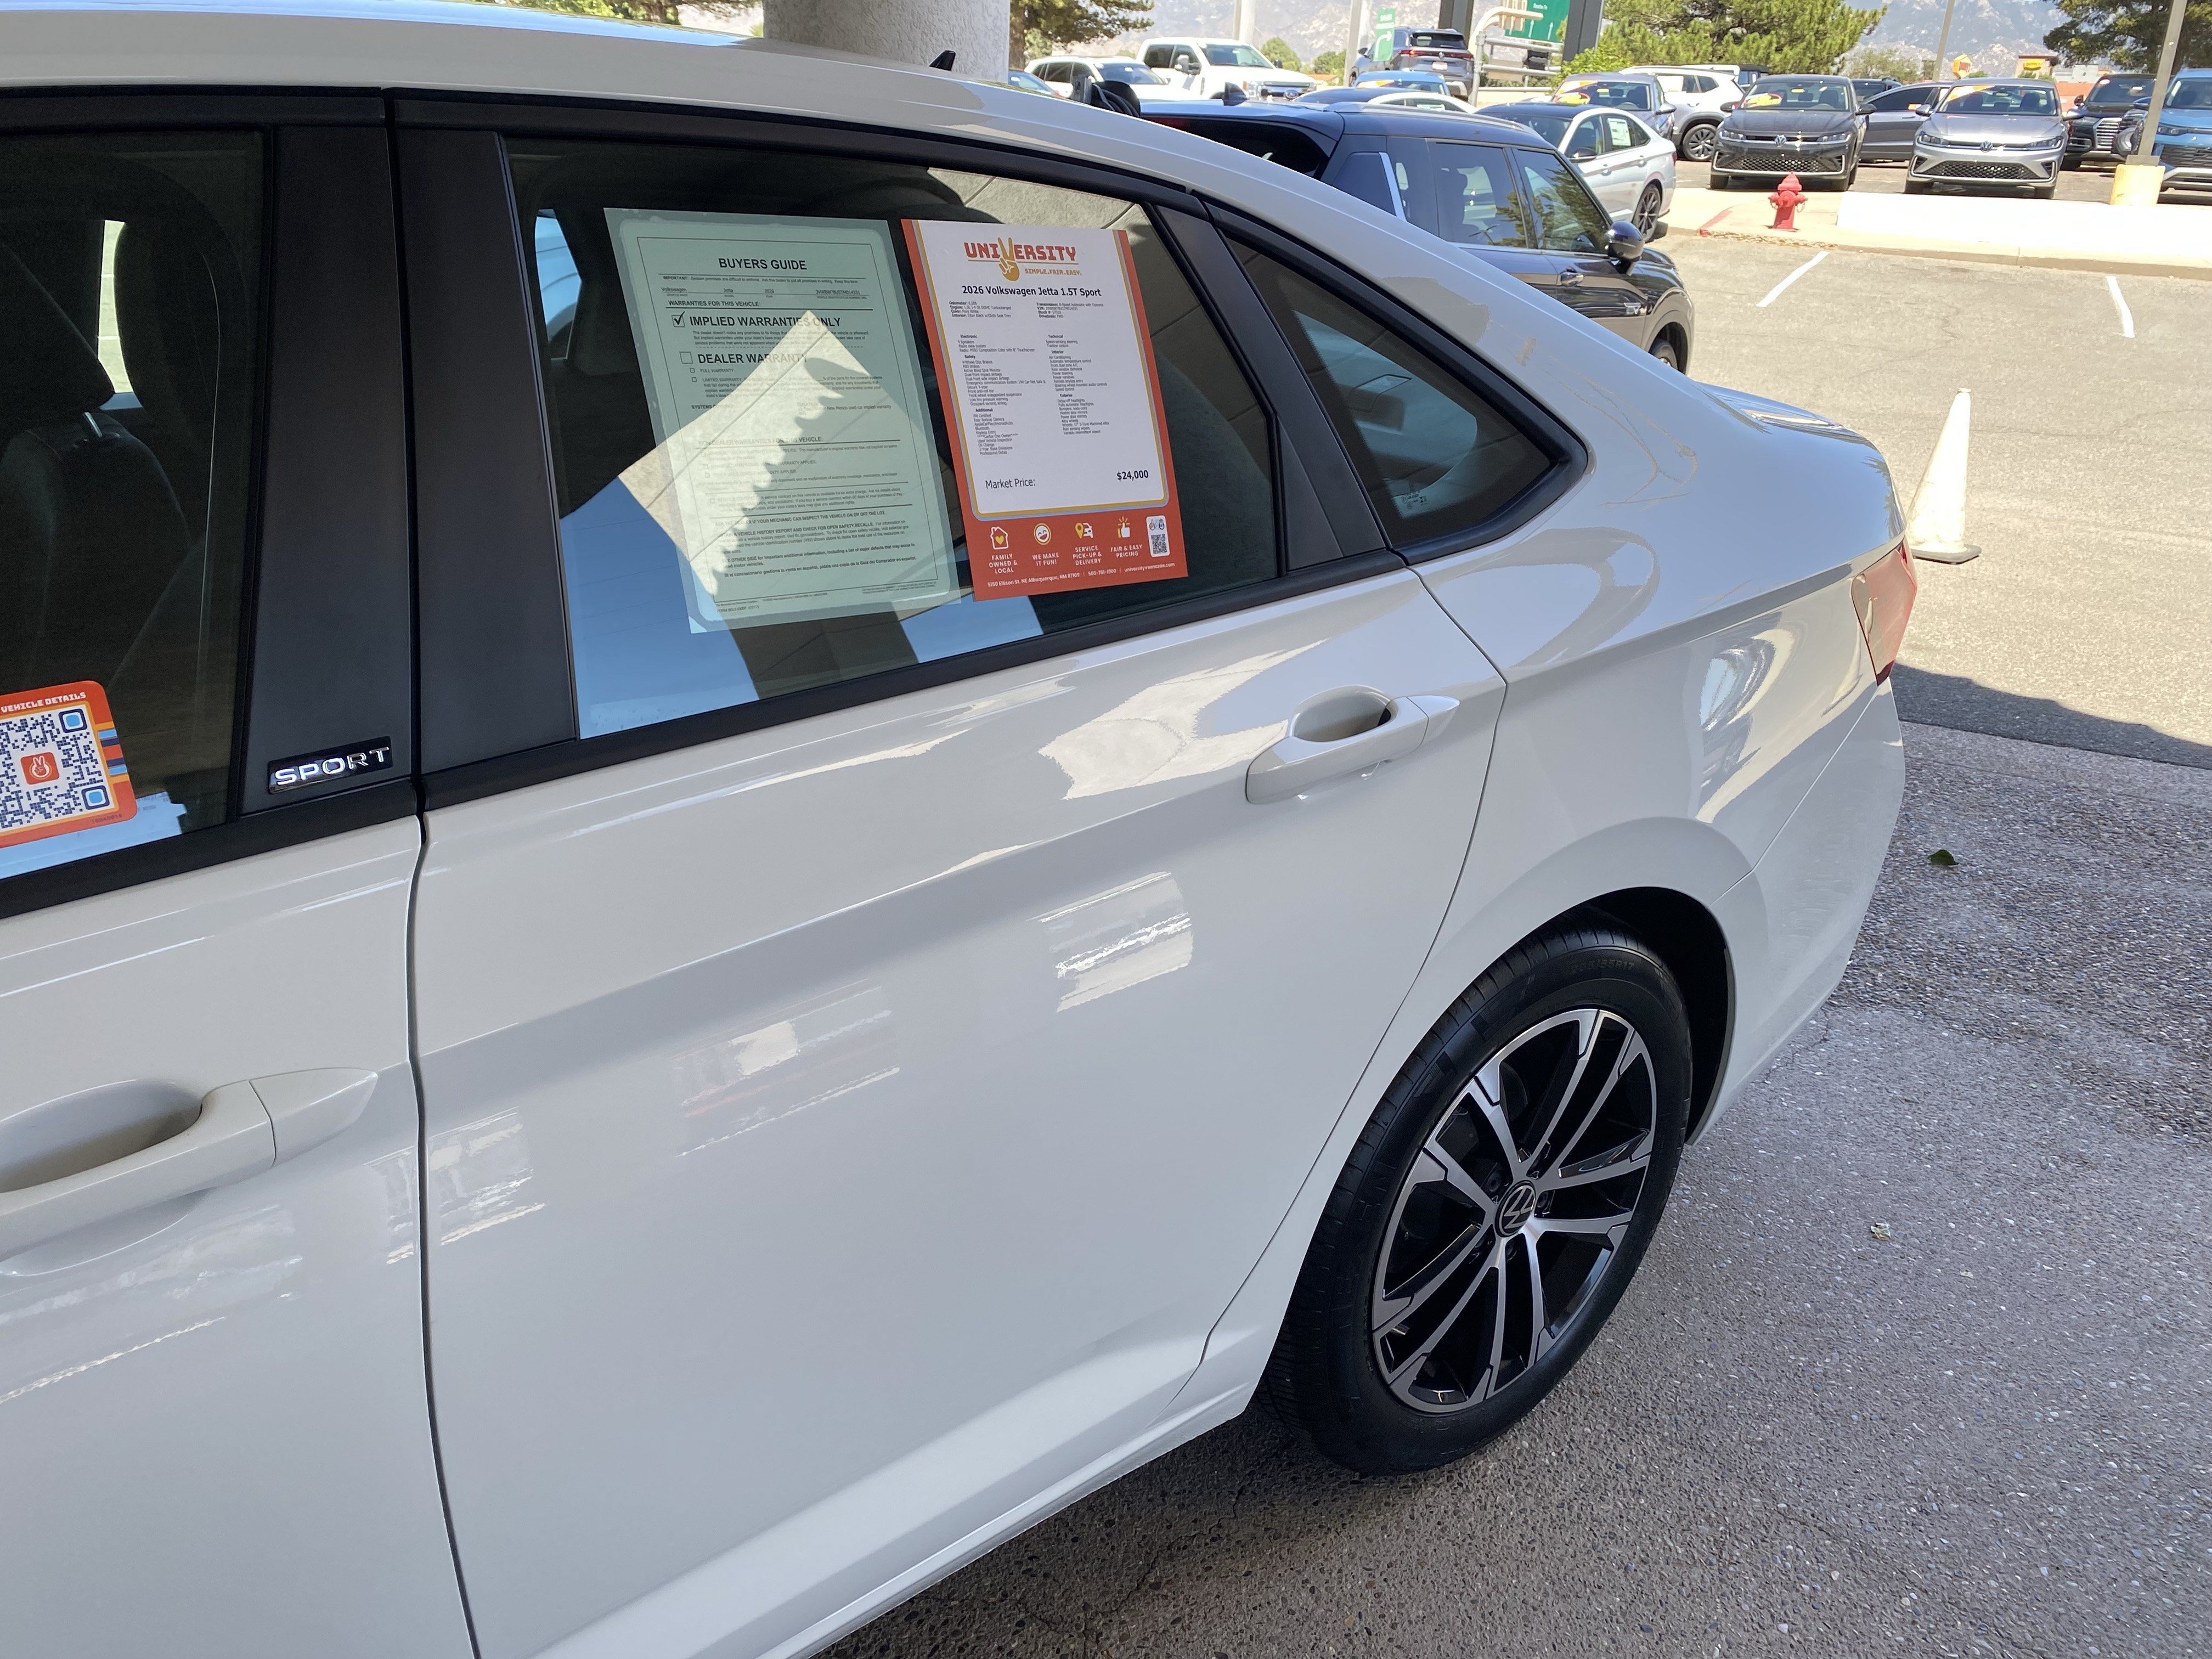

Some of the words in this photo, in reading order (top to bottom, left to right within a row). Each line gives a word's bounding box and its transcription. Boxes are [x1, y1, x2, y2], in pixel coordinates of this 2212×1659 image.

[718, 258, 768, 269] BUYERS
[771, 259, 807, 270] GUIDE
[962, 285, 984, 294] 2026
[985, 286, 1036, 297] Volkswagen
[1060, 287, 1077, 296] 1.5T
[1080, 288, 1102, 298] Sport
[690, 316, 735, 326] IMPLIED
[737, 316, 810, 328] WARRANTIES
[816, 317, 840, 327] ONLY
[698, 354, 744, 363] DEALER
[745, 353, 806, 364] WARRANTY
[985, 479, 1013, 489] Market
[1014, 478, 1036, 487] Price:
[1117, 470, 1149, 481] $24,000
[1, 699, 43, 713] VEHICLE
[45, 692, 86, 705] DETAILS
[275, 747, 390, 785] SPORT
